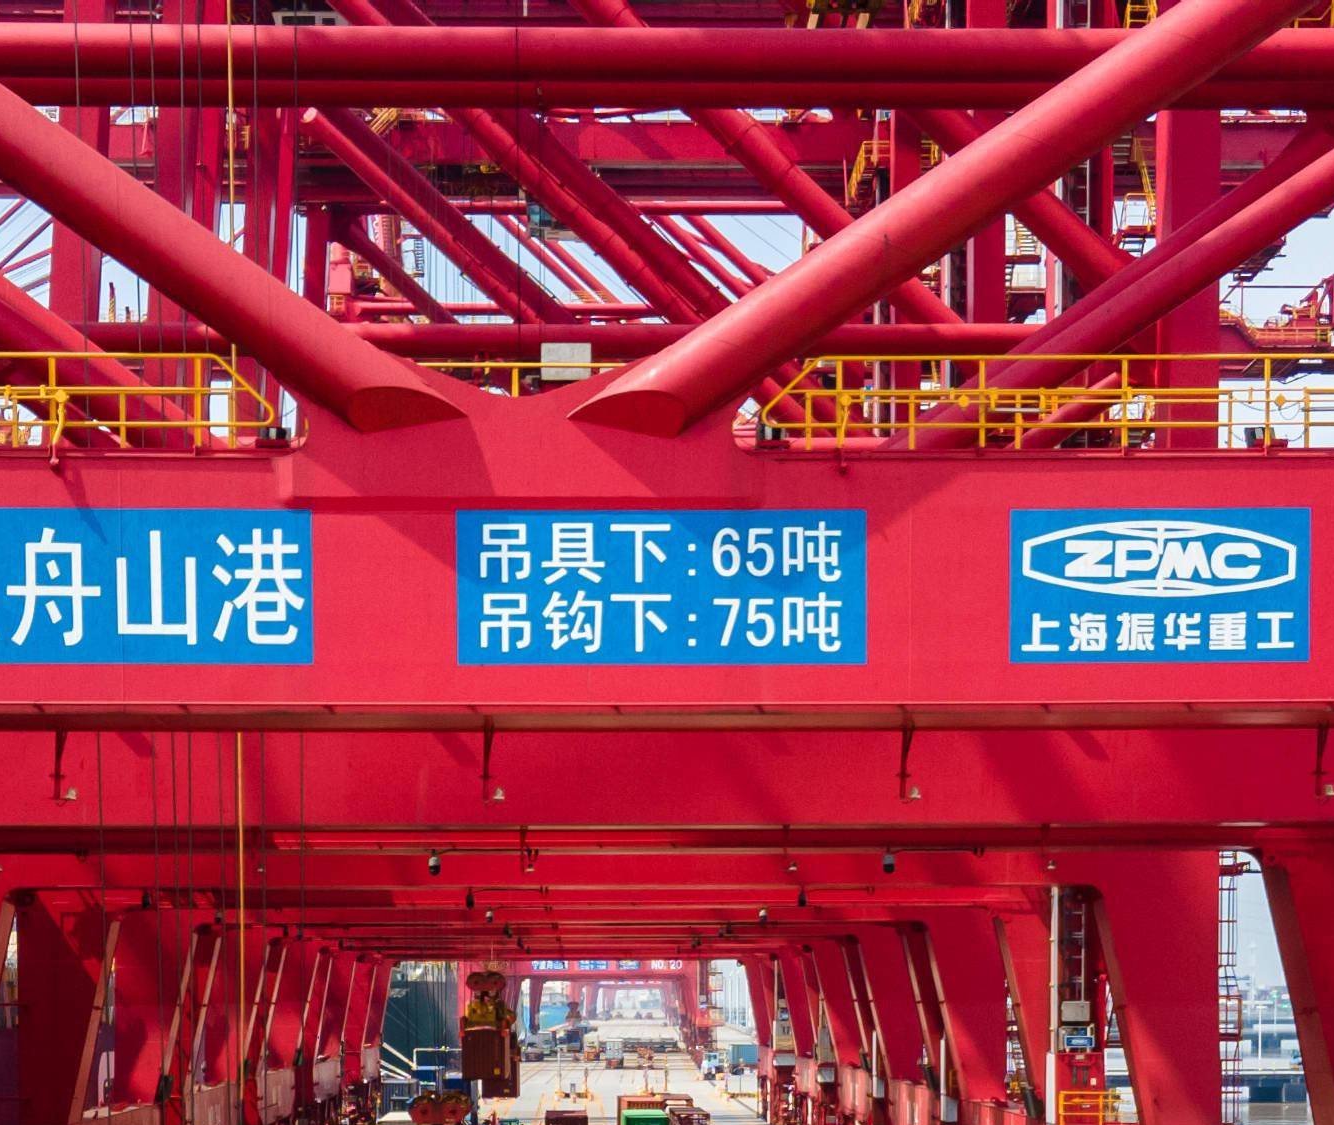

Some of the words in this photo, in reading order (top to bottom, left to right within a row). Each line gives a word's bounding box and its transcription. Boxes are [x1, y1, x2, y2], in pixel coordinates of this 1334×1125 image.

[480, 521, 842, 584] 吊具下:65吨
[1064, 540, 1262, 579] ZPMC
[480, 591, 842, 653] 吊钩下:75吨
[1021, 611, 1295, 651] 上海振华重工
